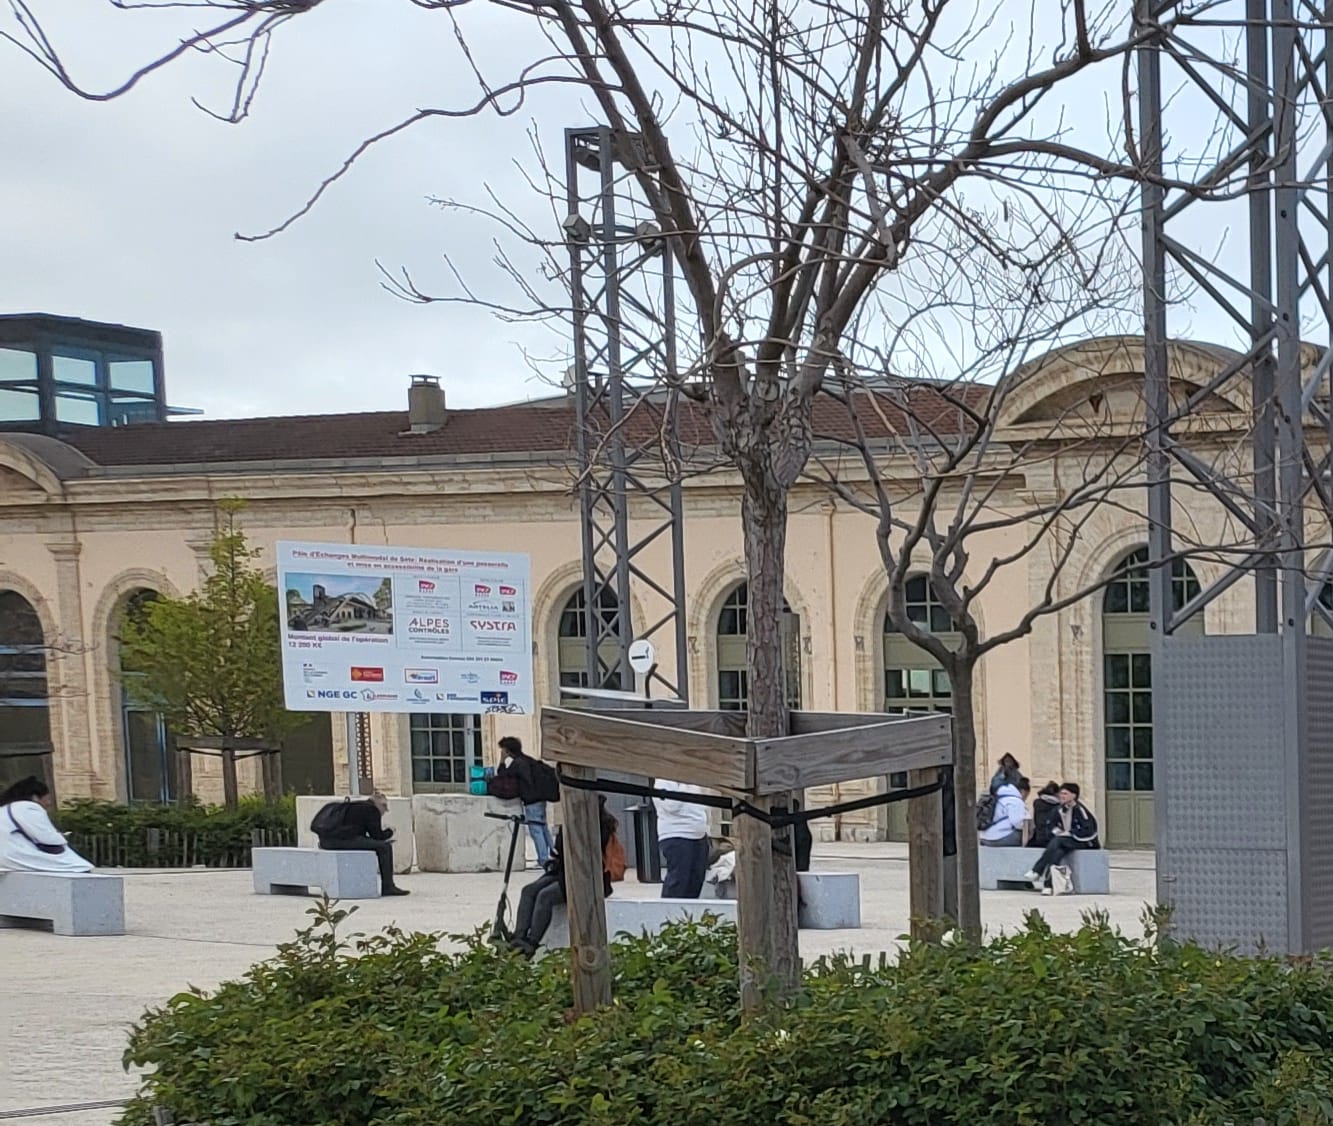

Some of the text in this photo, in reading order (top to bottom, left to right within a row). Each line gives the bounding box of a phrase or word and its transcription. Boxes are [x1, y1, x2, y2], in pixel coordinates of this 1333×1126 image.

[408, 617, 450, 628] ALPES
[408, 627, 450, 635] CONTRÔLES
[317, 690, 358, 699] NGE GC
